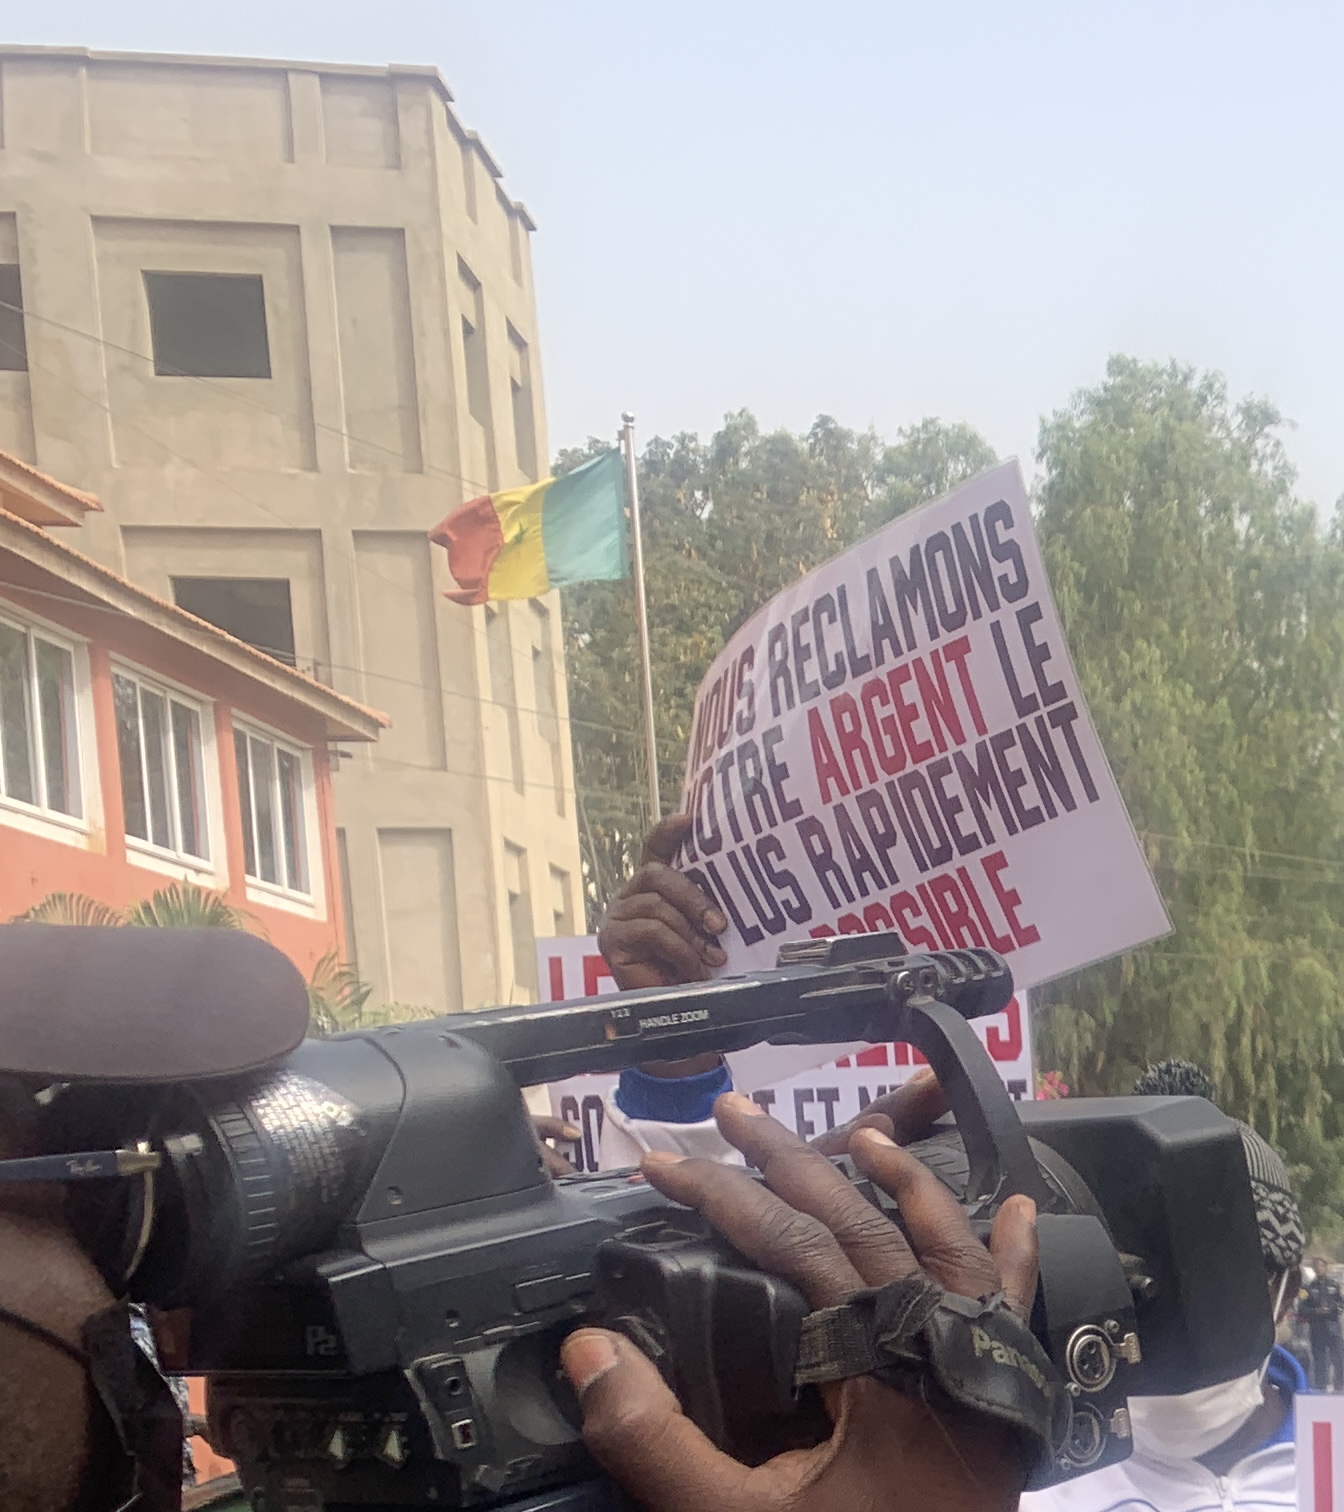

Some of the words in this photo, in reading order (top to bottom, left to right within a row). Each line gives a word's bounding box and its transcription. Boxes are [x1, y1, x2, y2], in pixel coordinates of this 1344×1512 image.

[767, 500, 1031, 717] RECLAMONS
[805, 636, 988, 804] ARGENT
[991, 601, 1069, 718] LE
[794, 702, 1100, 910] RAPIDEMENT
[808, 850, 1042, 958] SIBLE
[640, 1014, 680, 1028] HANDLE
[681, 1009, 710, 1022] ZOOM
